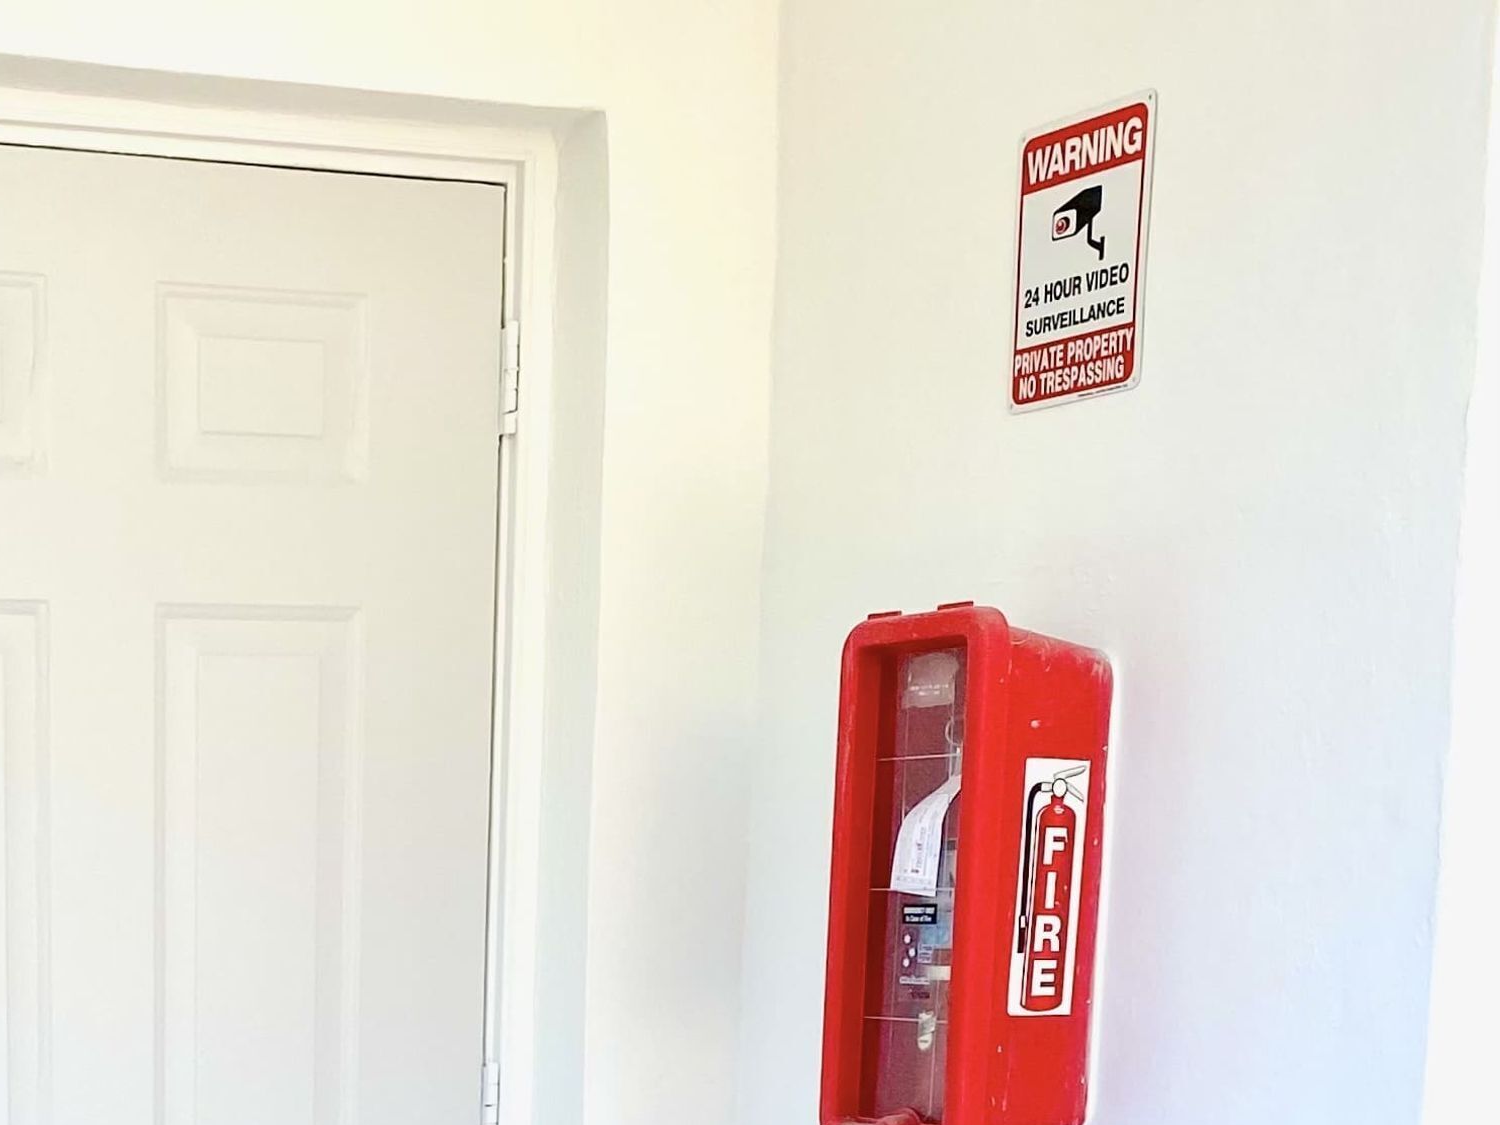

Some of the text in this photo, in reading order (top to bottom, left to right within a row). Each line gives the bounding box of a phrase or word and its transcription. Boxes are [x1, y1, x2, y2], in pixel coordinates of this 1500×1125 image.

[1027, 116, 1143, 185] WARNING
[1024, 263, 1129, 309] 24 HOUR VIDEO
[1025, 297, 1125, 337] SURVEILLANCE
[1014, 327, 1134, 377] PRIVATE PROPERTY
[1018, 375, 1037, 400] NO
[1040, 355, 1125, 395] TRESPASSING
[1030, 826, 1068, 998] FIRE
